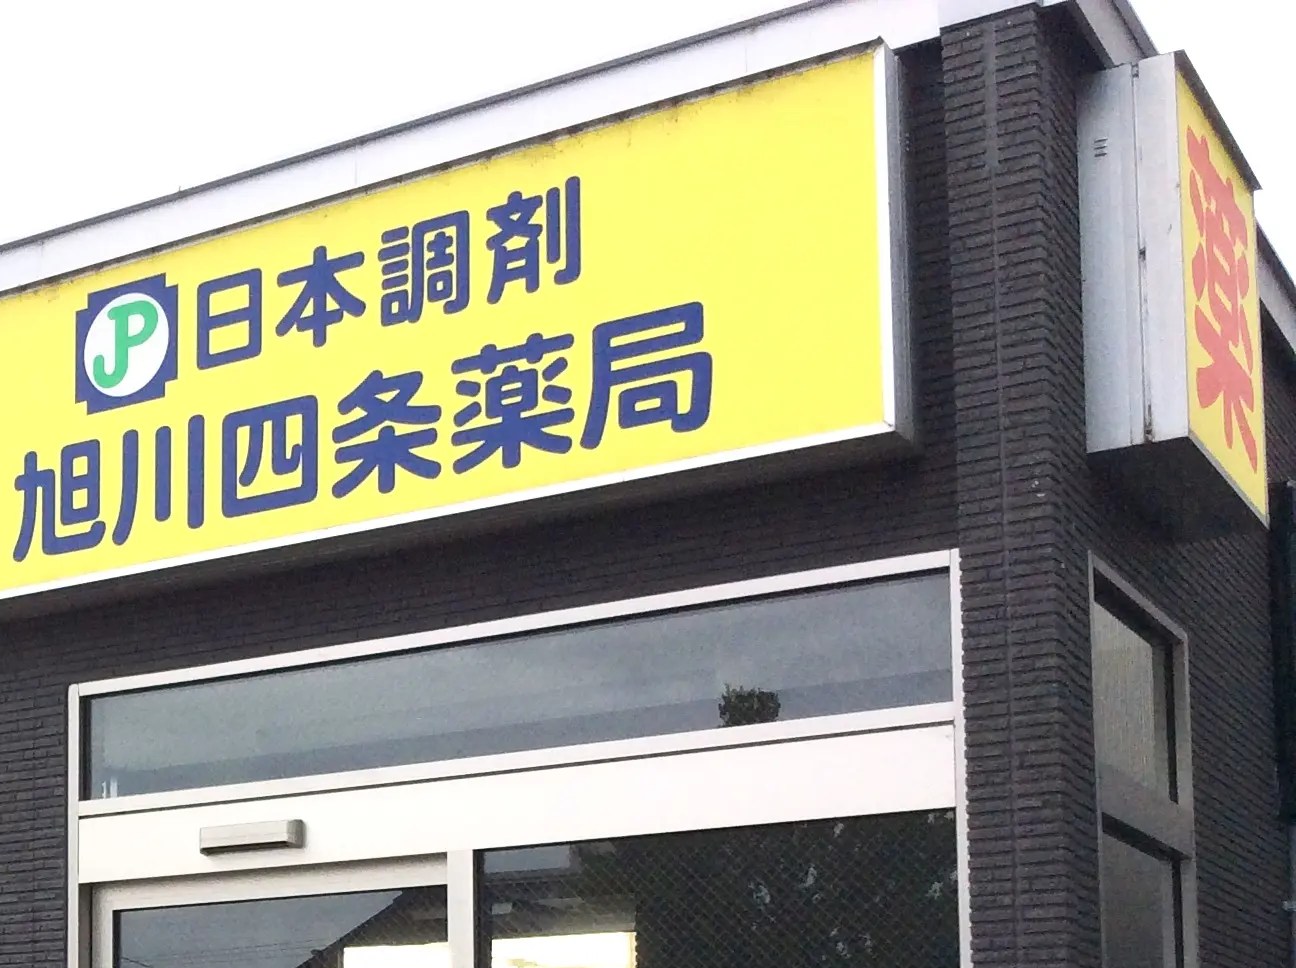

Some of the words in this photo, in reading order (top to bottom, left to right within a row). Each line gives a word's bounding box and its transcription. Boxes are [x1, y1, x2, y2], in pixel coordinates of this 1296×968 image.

[196, 176, 582, 370] 日本調剤
[1186, 124, 1258, 474] 薬
[13, 301, 713, 561] 旭川四条薬局
